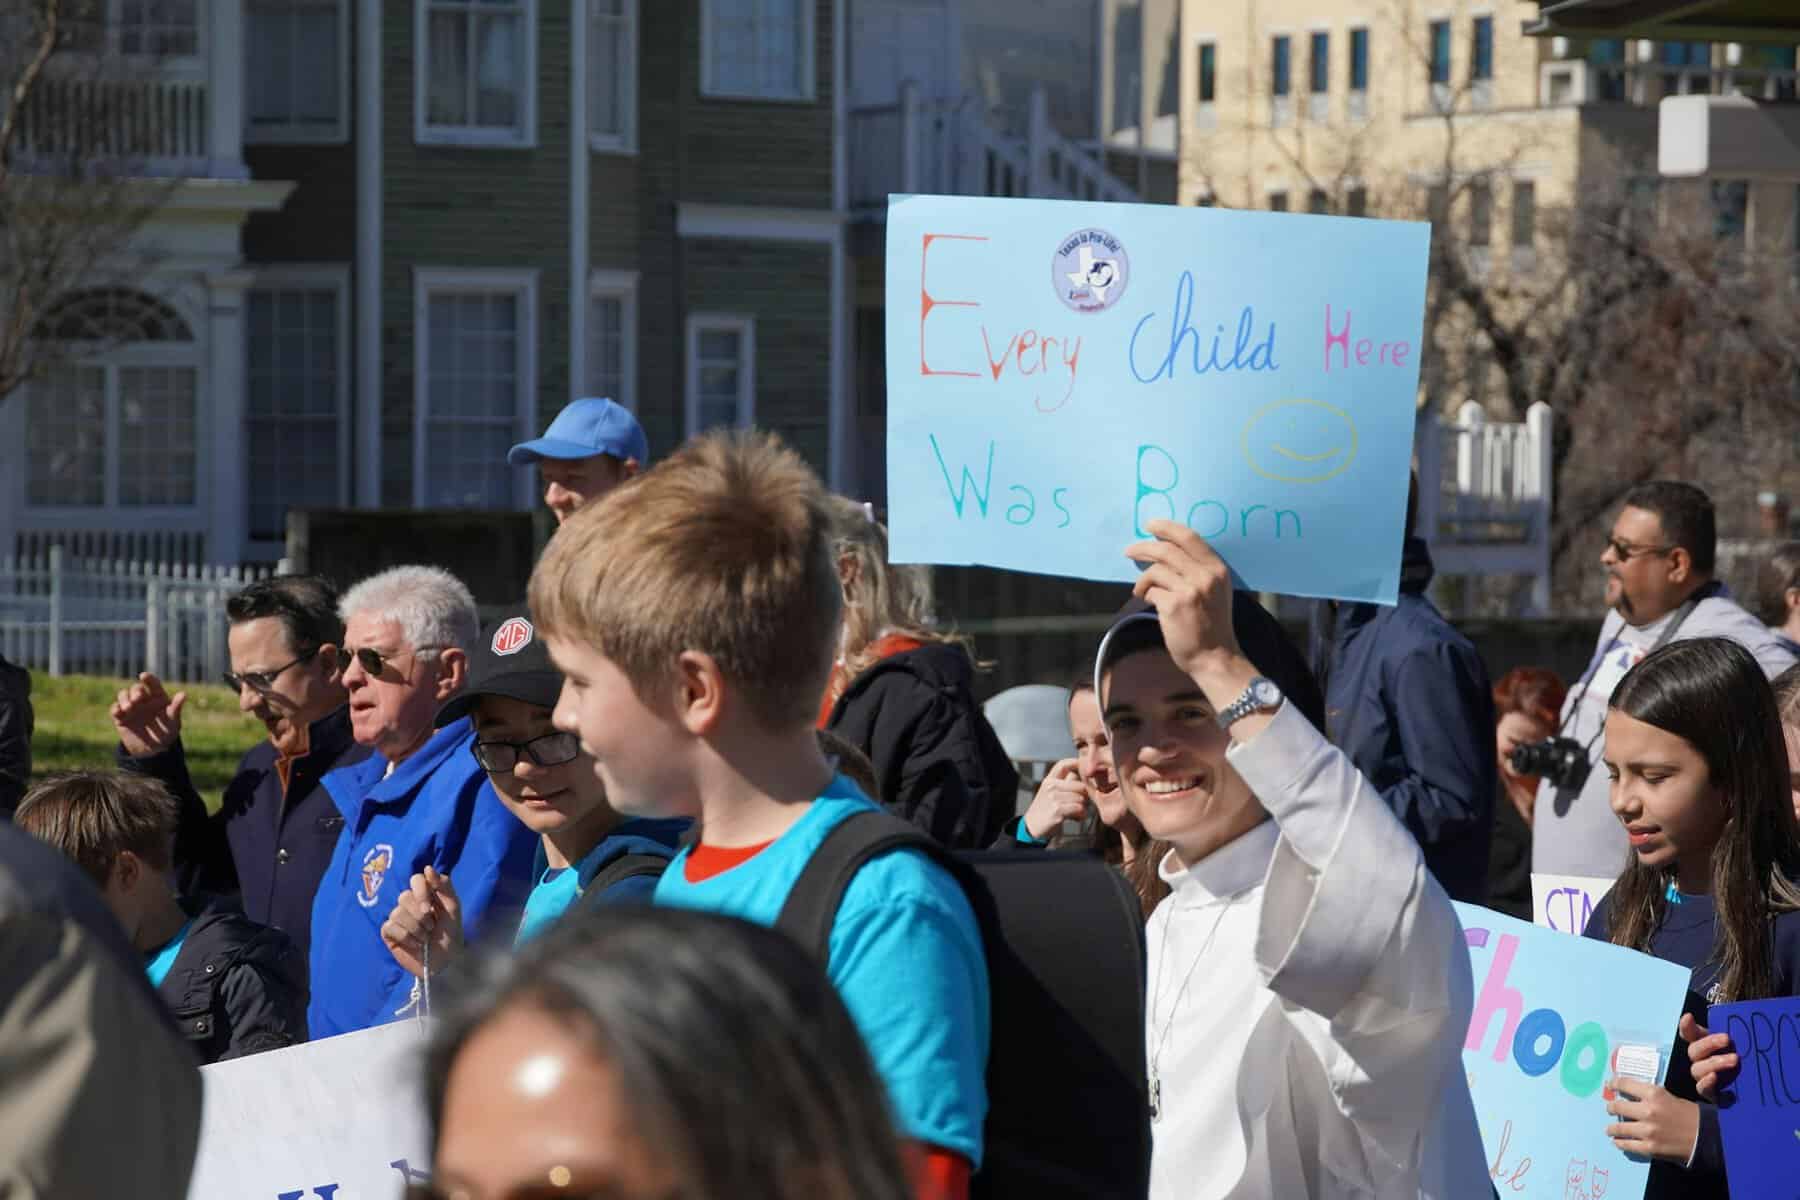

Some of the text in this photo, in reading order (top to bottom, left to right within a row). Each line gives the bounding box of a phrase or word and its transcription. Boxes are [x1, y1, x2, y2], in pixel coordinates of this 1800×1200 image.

[920, 233, 1410, 413] Every Child Here
[929, 433, 1302, 539] Was Born
[496, 623, 527, 650] MG
